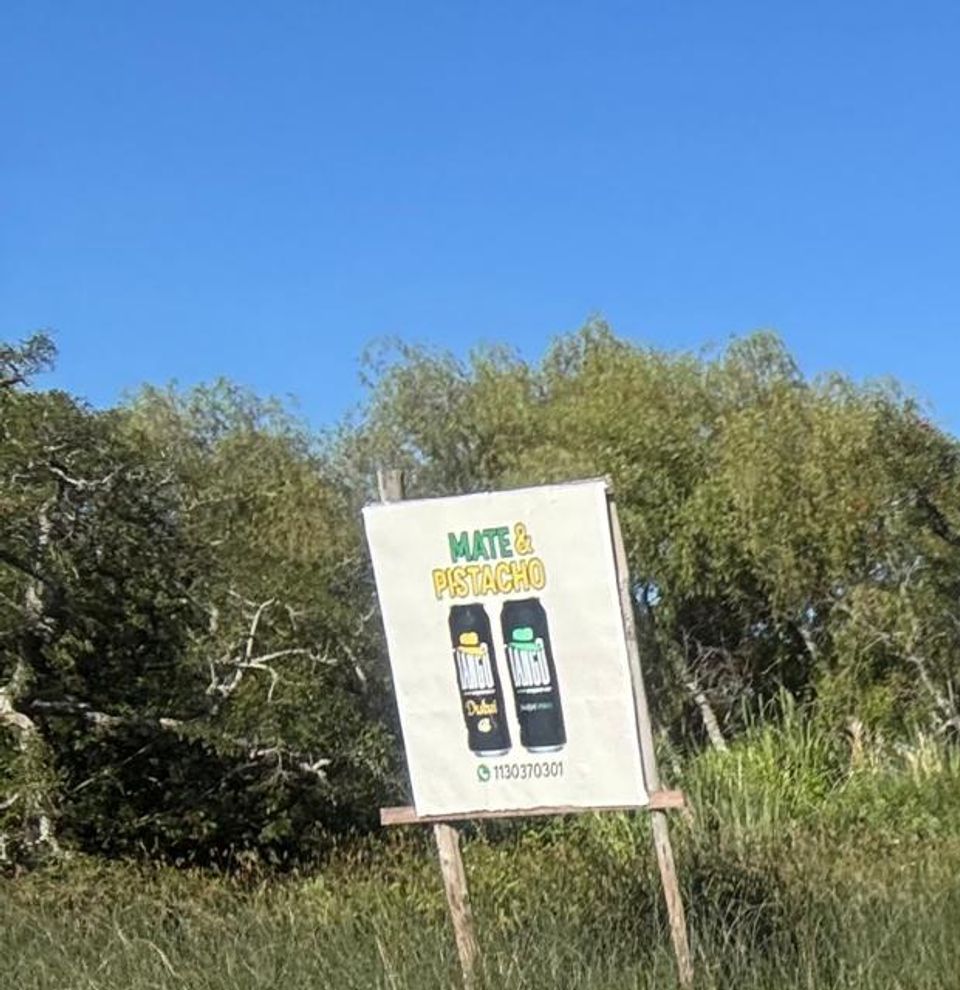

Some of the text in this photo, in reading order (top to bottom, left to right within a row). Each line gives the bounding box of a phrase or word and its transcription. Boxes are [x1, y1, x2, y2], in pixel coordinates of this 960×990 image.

[448, 522, 535, 563] MATE &
[432, 557, 546, 600] PISTACHO
[494, 761, 563, 779] 1130370301
